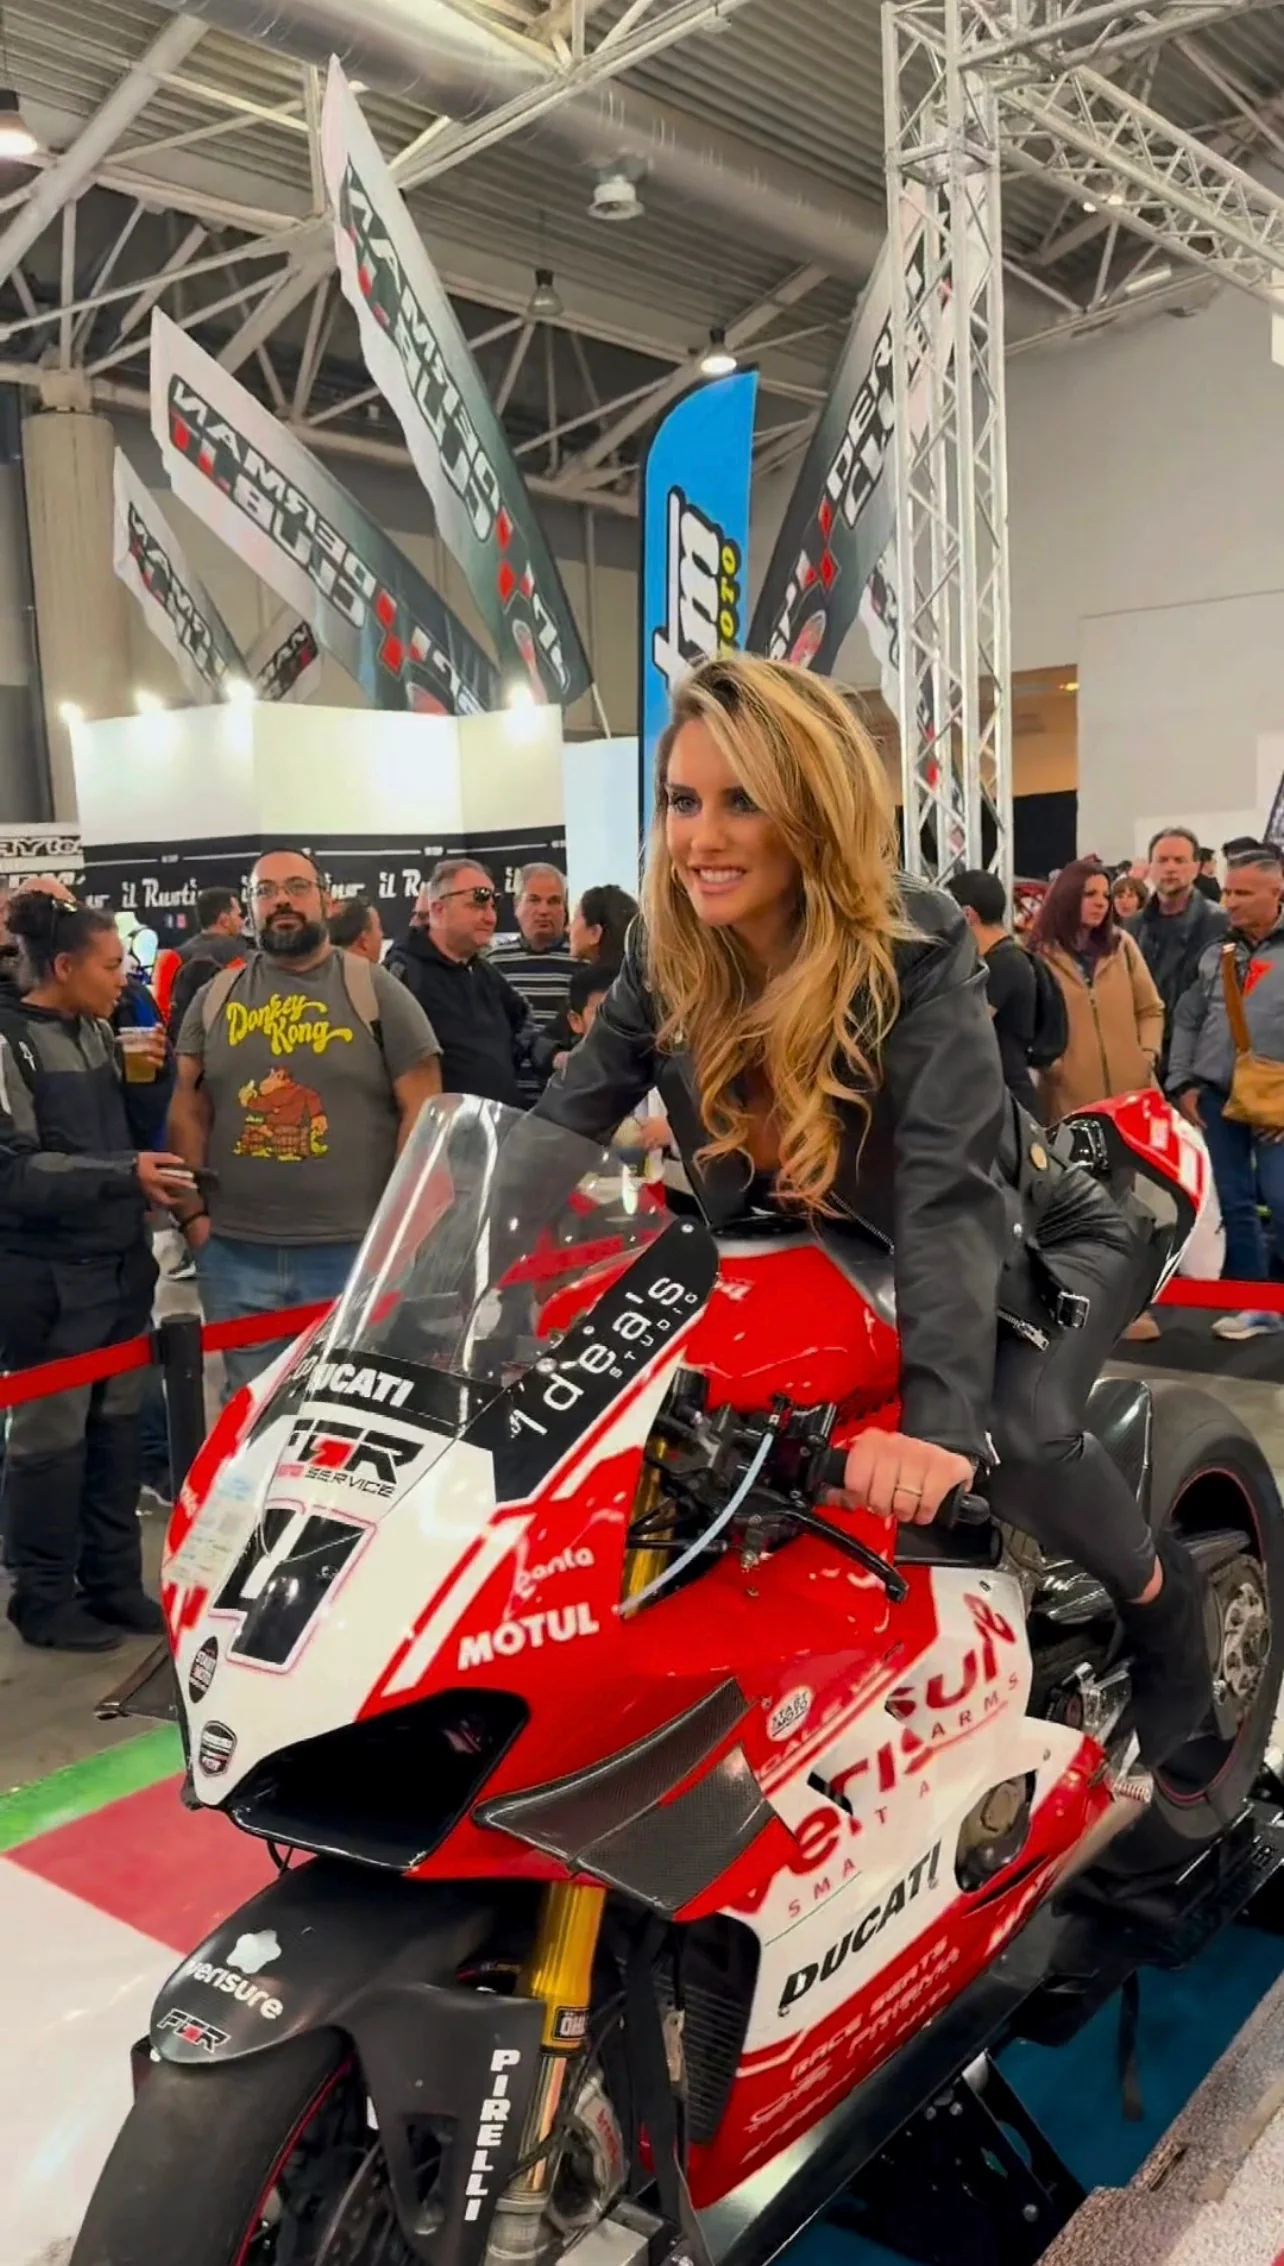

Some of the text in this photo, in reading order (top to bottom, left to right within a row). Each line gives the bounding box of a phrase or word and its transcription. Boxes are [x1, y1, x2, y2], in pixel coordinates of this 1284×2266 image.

[226, 993, 328, 1046] Donkey
[265, 1016, 353, 1056] Kong
[609, 1292, 699, 1380] STUDIO
[305, 1467, 396, 1500] SERVICE
[457, 1602, 600, 1671] MOTUL
[779, 1837, 942, 2009] DUCATI
[187, 1959, 284, 2020] verisure
[464, 2048, 521, 2222] PIRELLI
